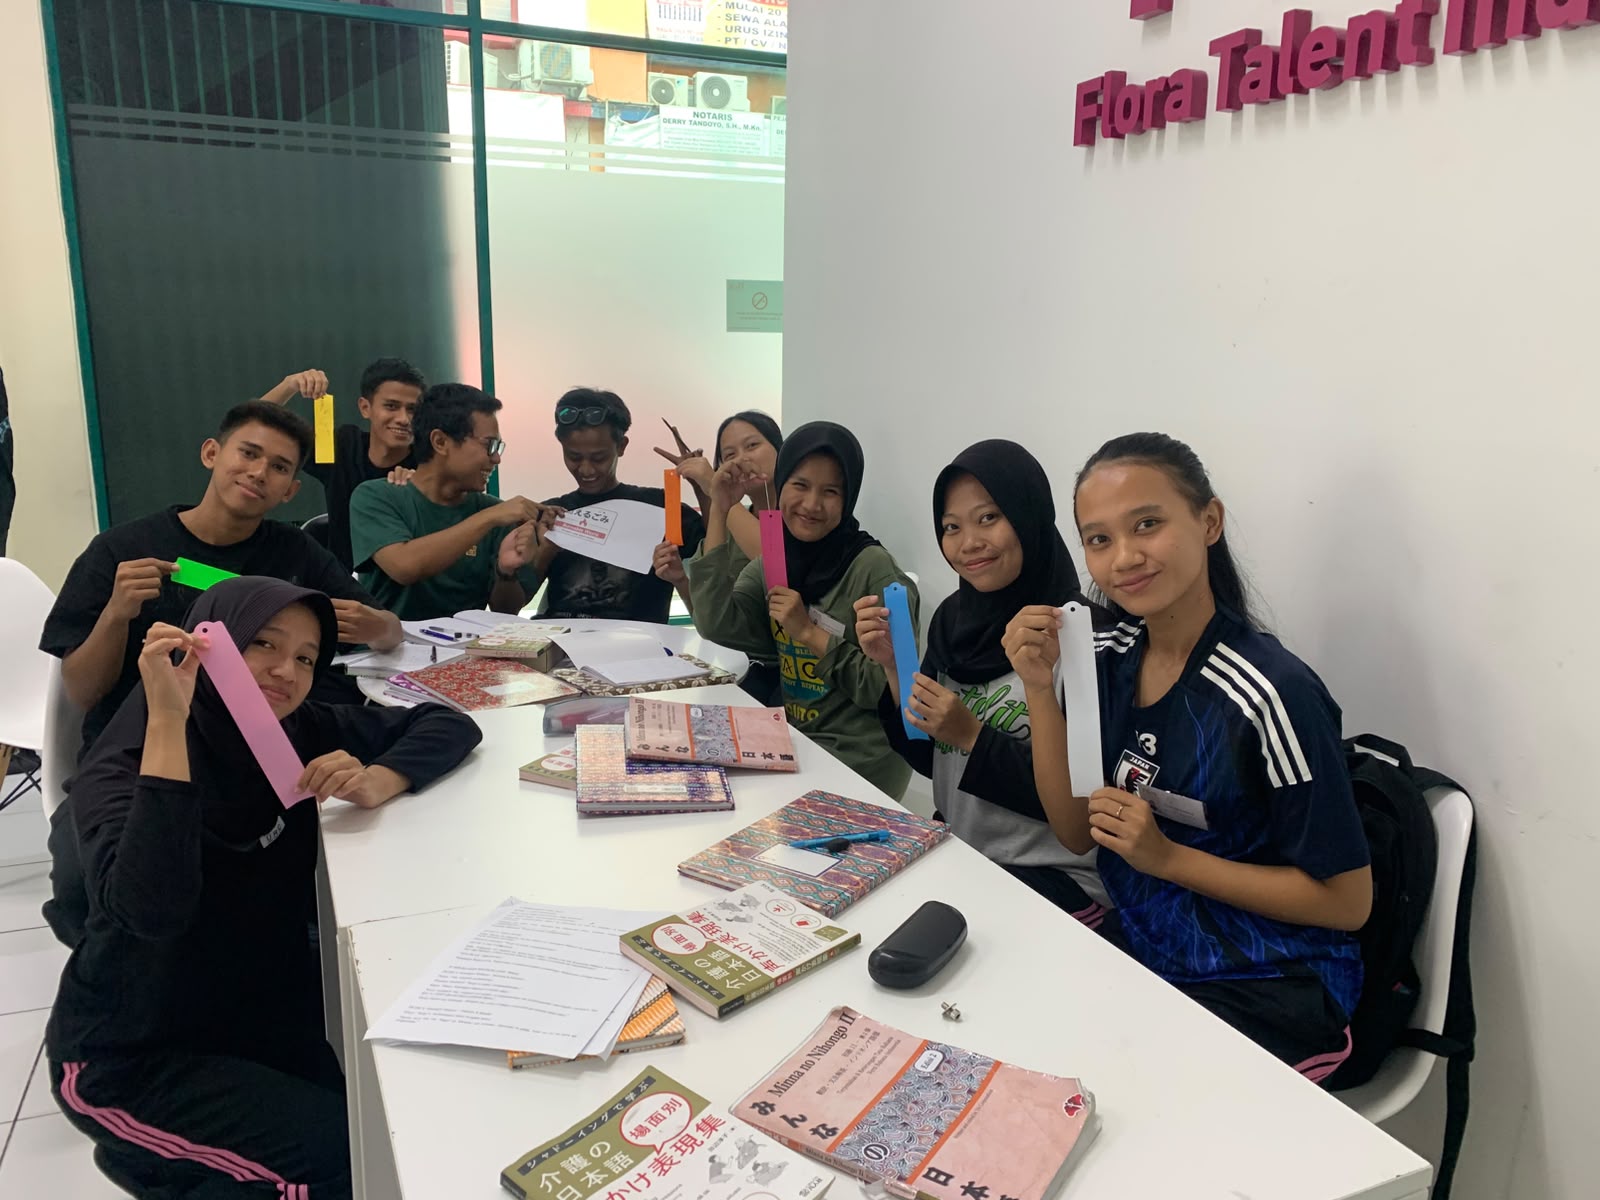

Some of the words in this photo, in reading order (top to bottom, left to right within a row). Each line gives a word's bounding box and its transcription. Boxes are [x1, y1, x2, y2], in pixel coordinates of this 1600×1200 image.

[725, 2, 763, 14] MULAI
[768, 8, 782, 16] 20
[725, 13, 760, 24] SEWA
[724, 36, 740, 45] PT
[751, 39, 768, 47] CV
[725, 25, 760, 36] URUS
[1073, 68, 1209, 147] Flora
[1209, 0, 1440, 113] Talent
[692, 111, 733, 121] NOTARIS
[1129, 756, 1150, 770] JAPAN
[659, 924, 698, 952] 場面別
[686, 910, 786, 974] 声かけ表現集
[694, 957, 746, 990] 介護の
[711, 949, 763, 984] 日本語
[806, 1025, 848, 1061] Nihongo
[800, 1059, 815, 1072] no
[767, 1070, 805, 1098] Minna
[527, 1081, 649, 1169] シャドーイングで学ぶ
[629, 1097, 683, 1140] 場面別
[539, 1140, 611, 1193] 介護の
[556, 1151, 635, 1200] 日本語
